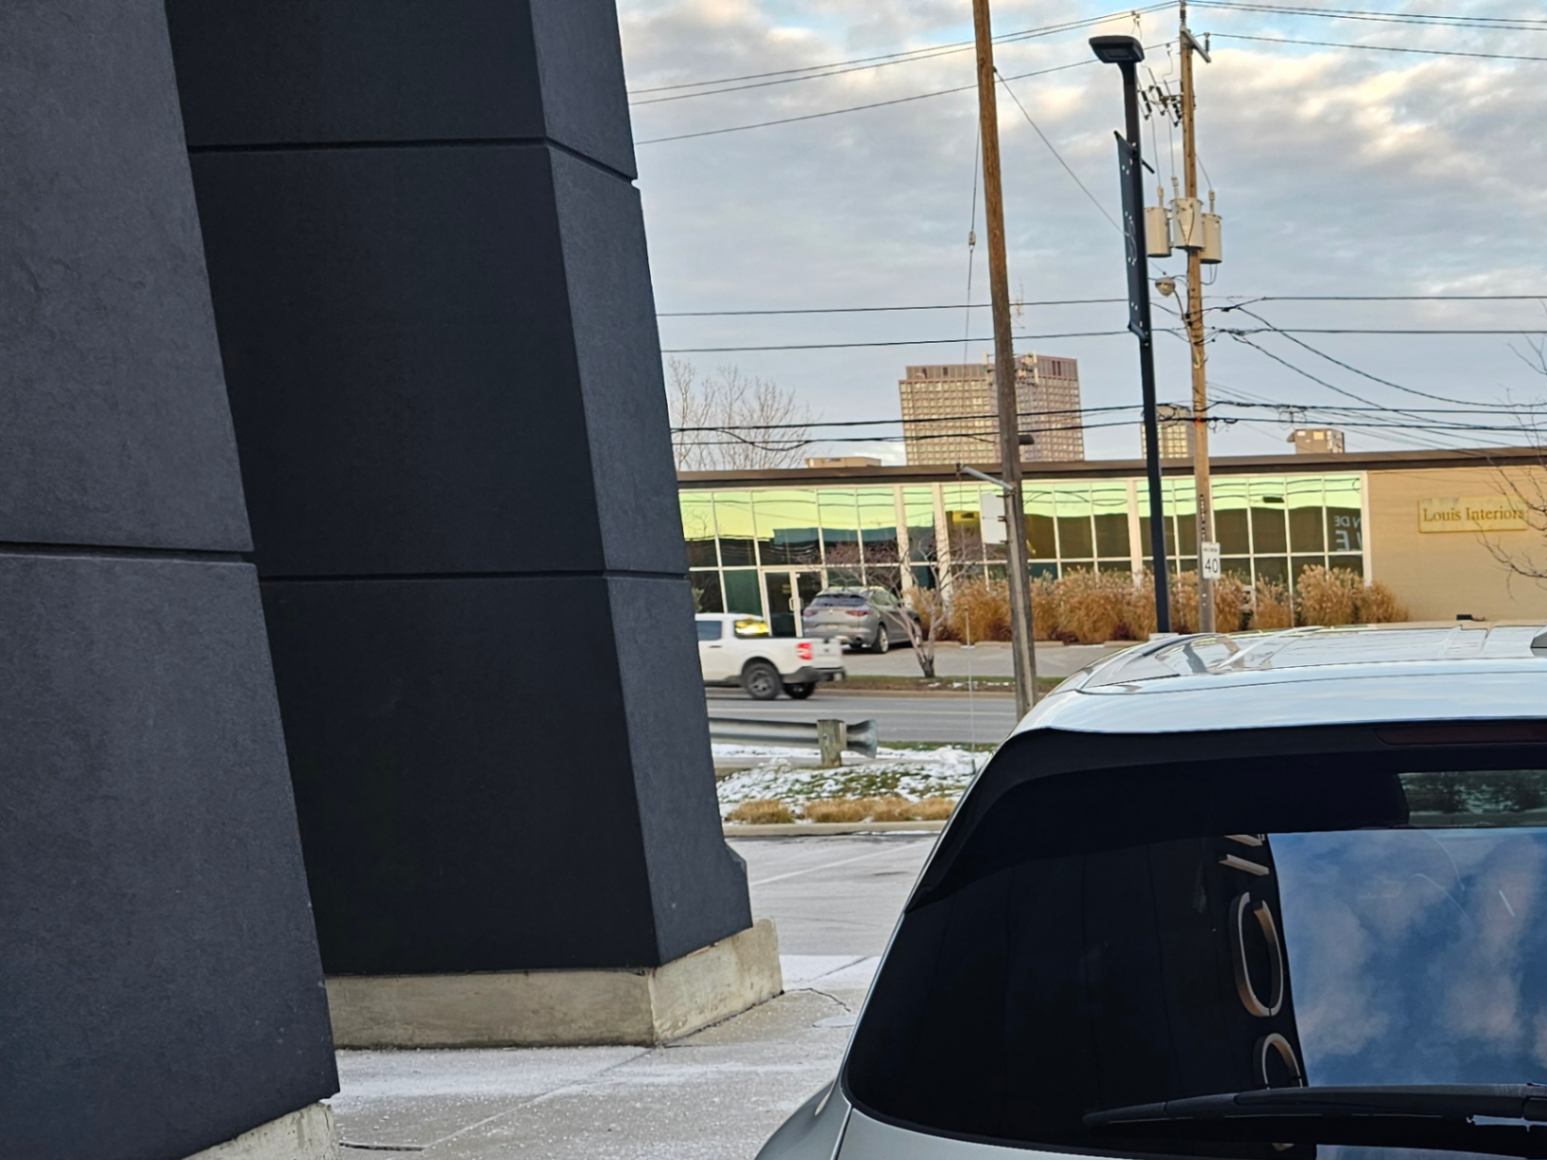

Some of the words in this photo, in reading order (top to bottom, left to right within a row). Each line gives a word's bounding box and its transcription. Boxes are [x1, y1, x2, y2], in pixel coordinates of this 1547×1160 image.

[1422, 507, 1461, 522] Louis
[1466, 505, 1524, 521] Interiors
[1205, 558, 1219, 574] 40
